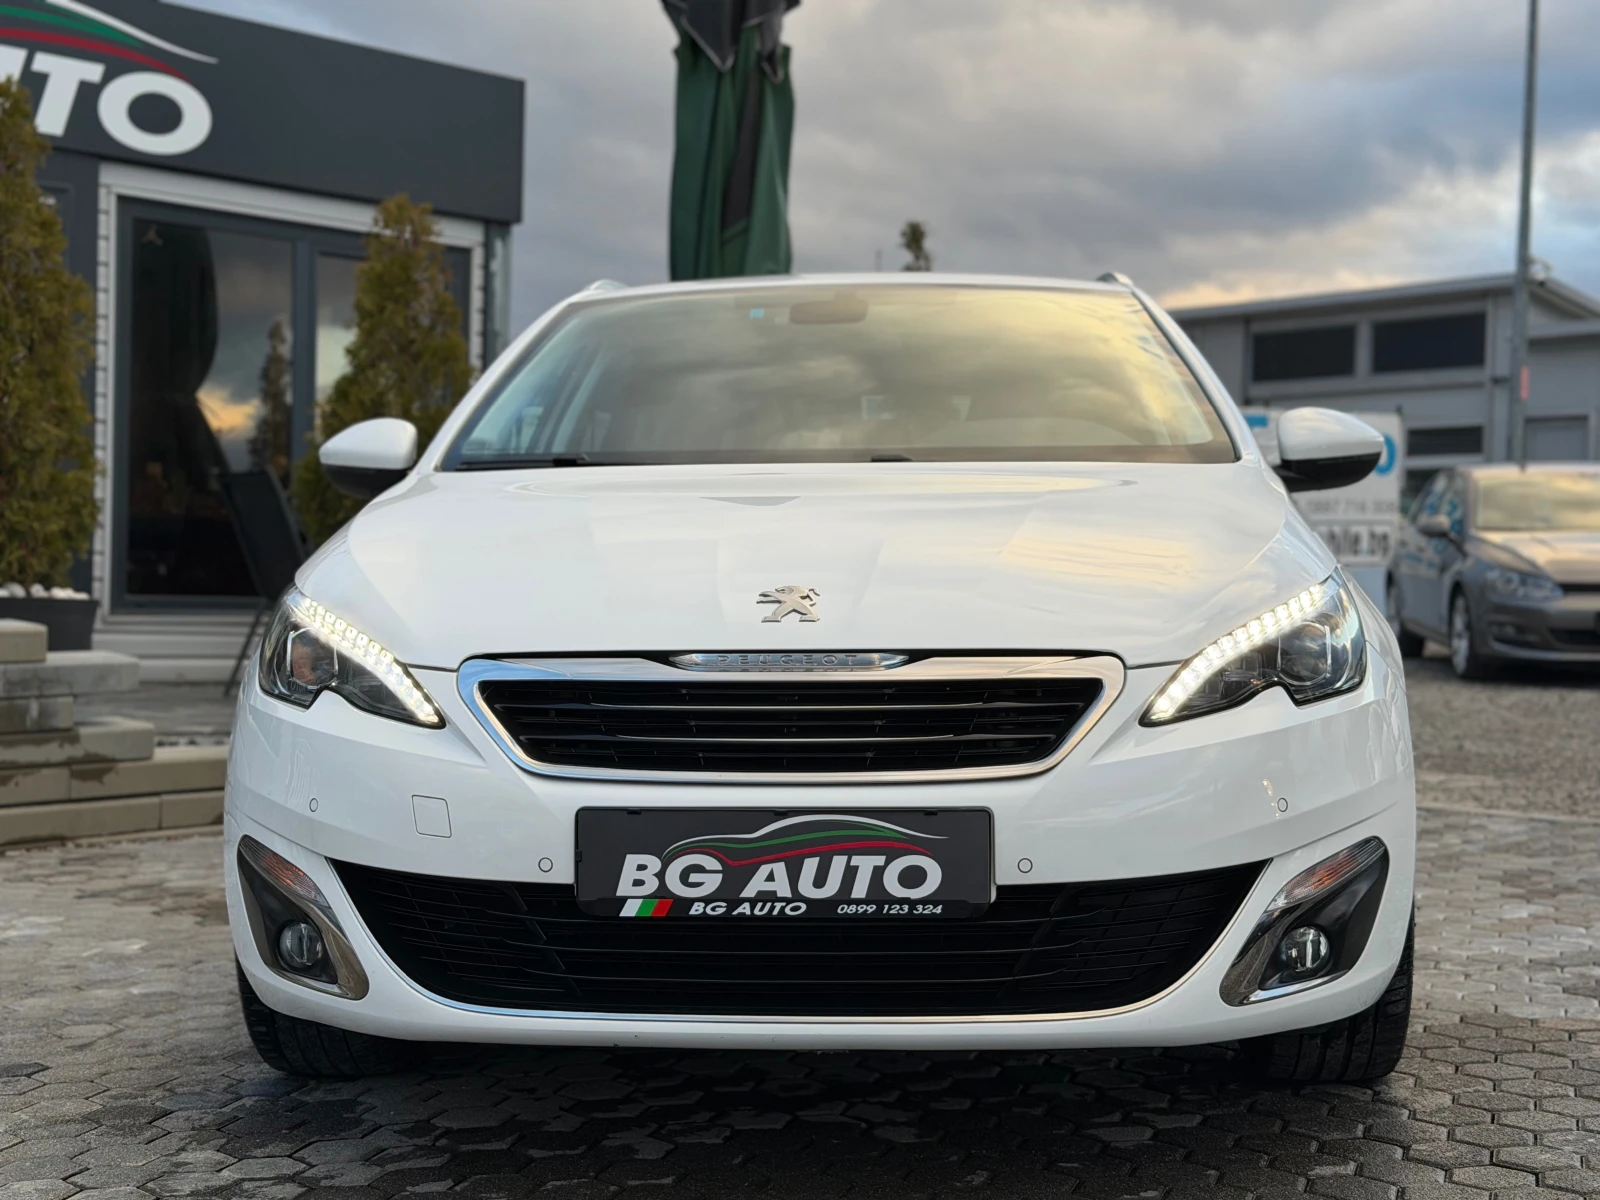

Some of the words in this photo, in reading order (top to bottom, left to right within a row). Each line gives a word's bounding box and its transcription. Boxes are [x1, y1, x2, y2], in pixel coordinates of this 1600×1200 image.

[715, 653, 859, 667] PEUGEOT
[615, 853, 723, 898] BG
[738, 854, 943, 900] AUTO
[688, 901, 728, 916] BG
[731, 901, 807, 916] AUTO
[836, 904, 877, 915] 0899
[882, 904, 909, 915] 123
[912, 904, 943, 915] 324
